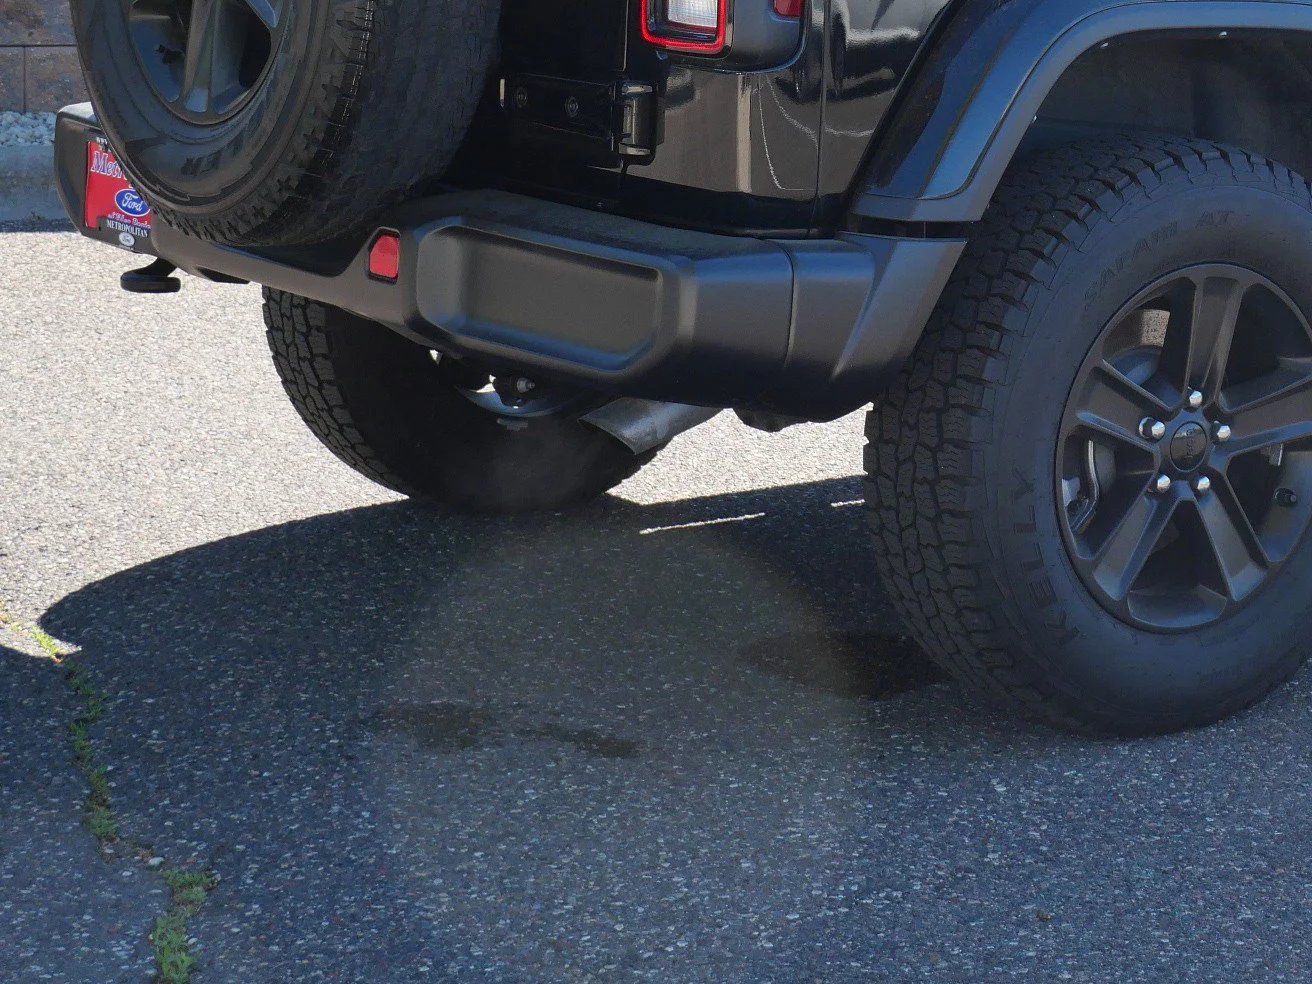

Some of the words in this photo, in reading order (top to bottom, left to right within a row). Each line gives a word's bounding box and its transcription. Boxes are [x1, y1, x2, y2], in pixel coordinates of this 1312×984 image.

[121, 192, 144, 212] Ford
[106, 219, 148, 237] METROPOLITAN
[1011, 466, 1082, 647] KELLY
